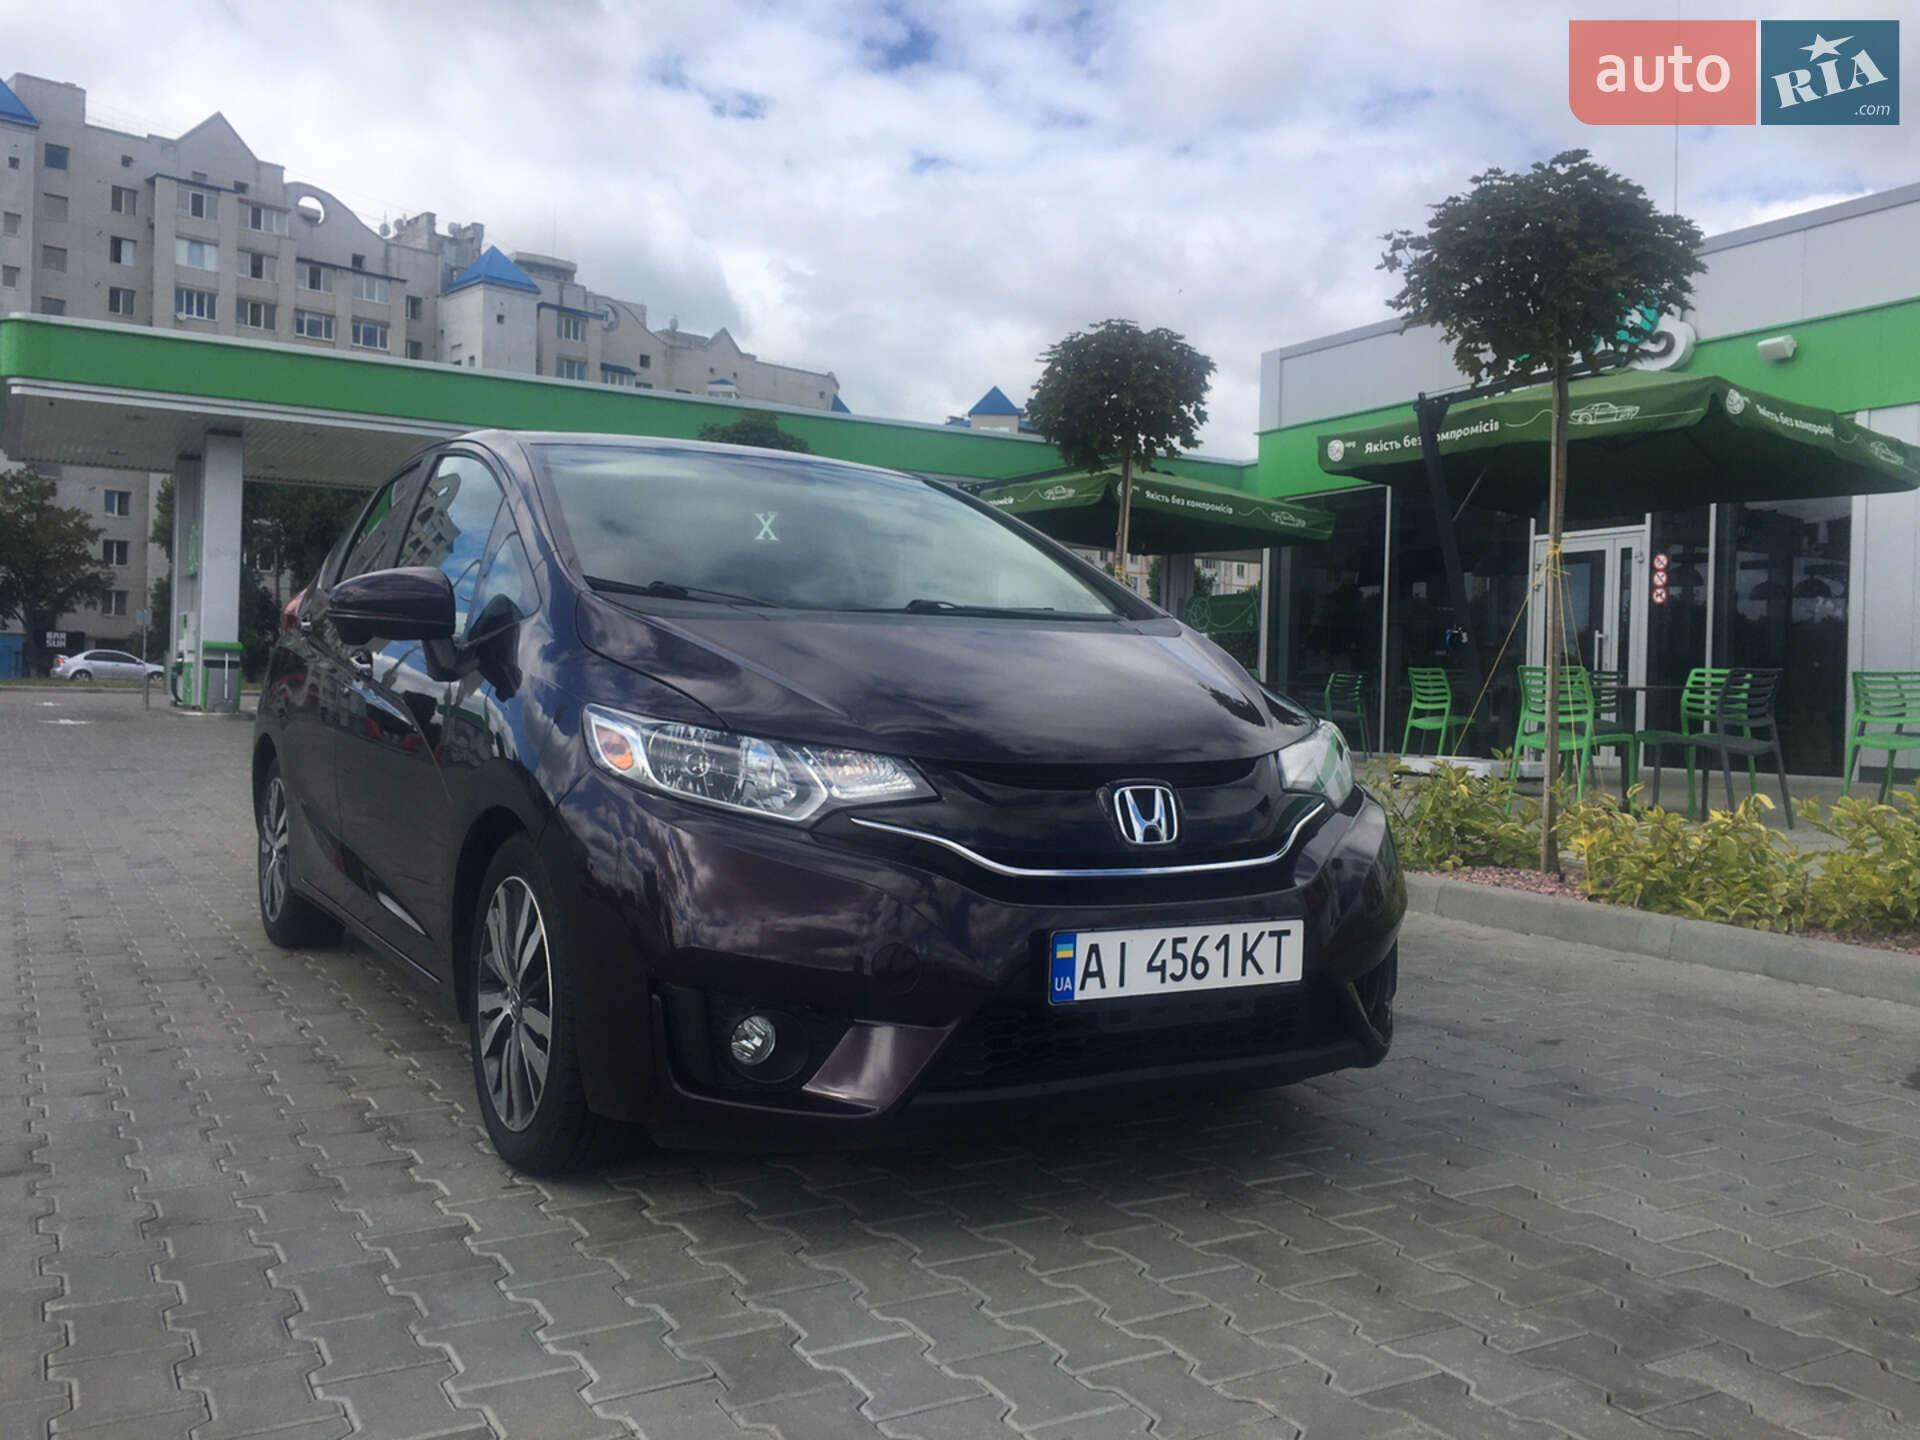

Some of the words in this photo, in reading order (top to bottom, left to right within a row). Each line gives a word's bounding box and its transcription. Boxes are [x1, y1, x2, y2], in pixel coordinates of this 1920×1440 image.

[1364, 439, 1401, 454] Якість
[1437, 419, 1500, 443] омпромісів
[1171, 494, 1185, 506] без
[1054, 976, 1073, 992] UA
